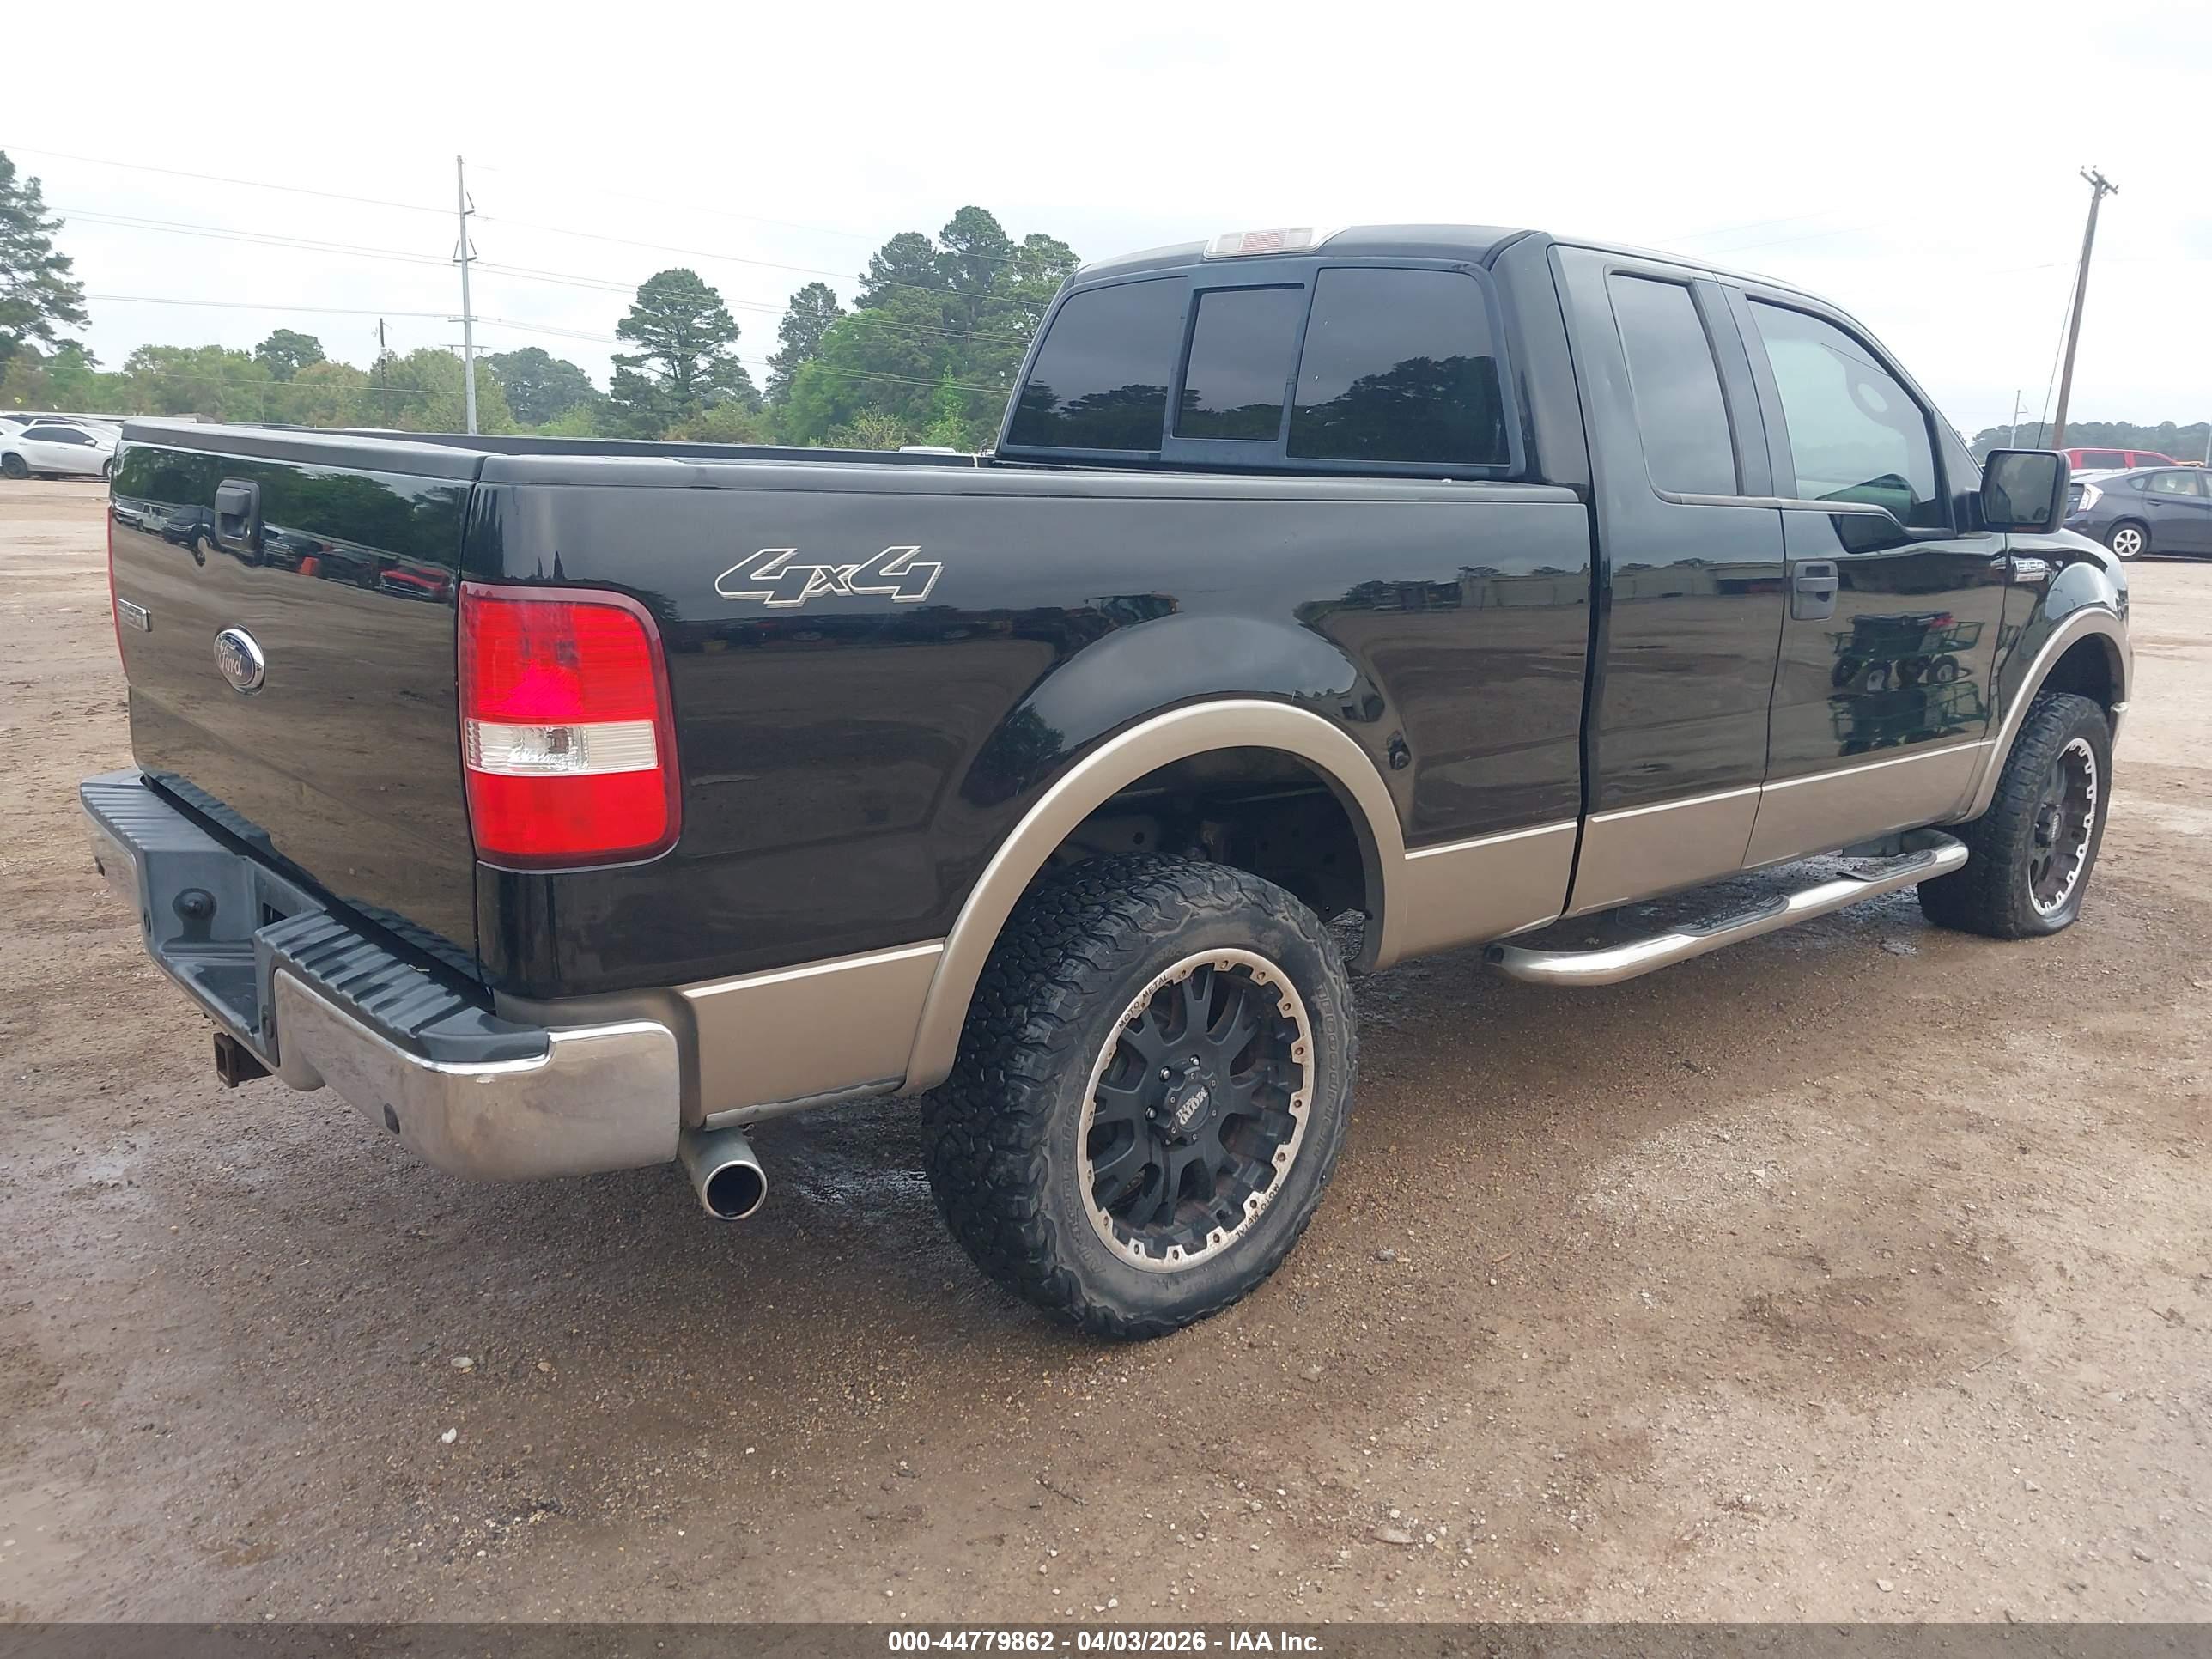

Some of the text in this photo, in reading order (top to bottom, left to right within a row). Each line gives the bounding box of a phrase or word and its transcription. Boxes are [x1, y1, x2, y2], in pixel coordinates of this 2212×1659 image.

[714, 545, 944, 608] 4x4
[219, 638, 243, 677] Ford
[1118, 975, 1169, 1030] MOTO METAL
